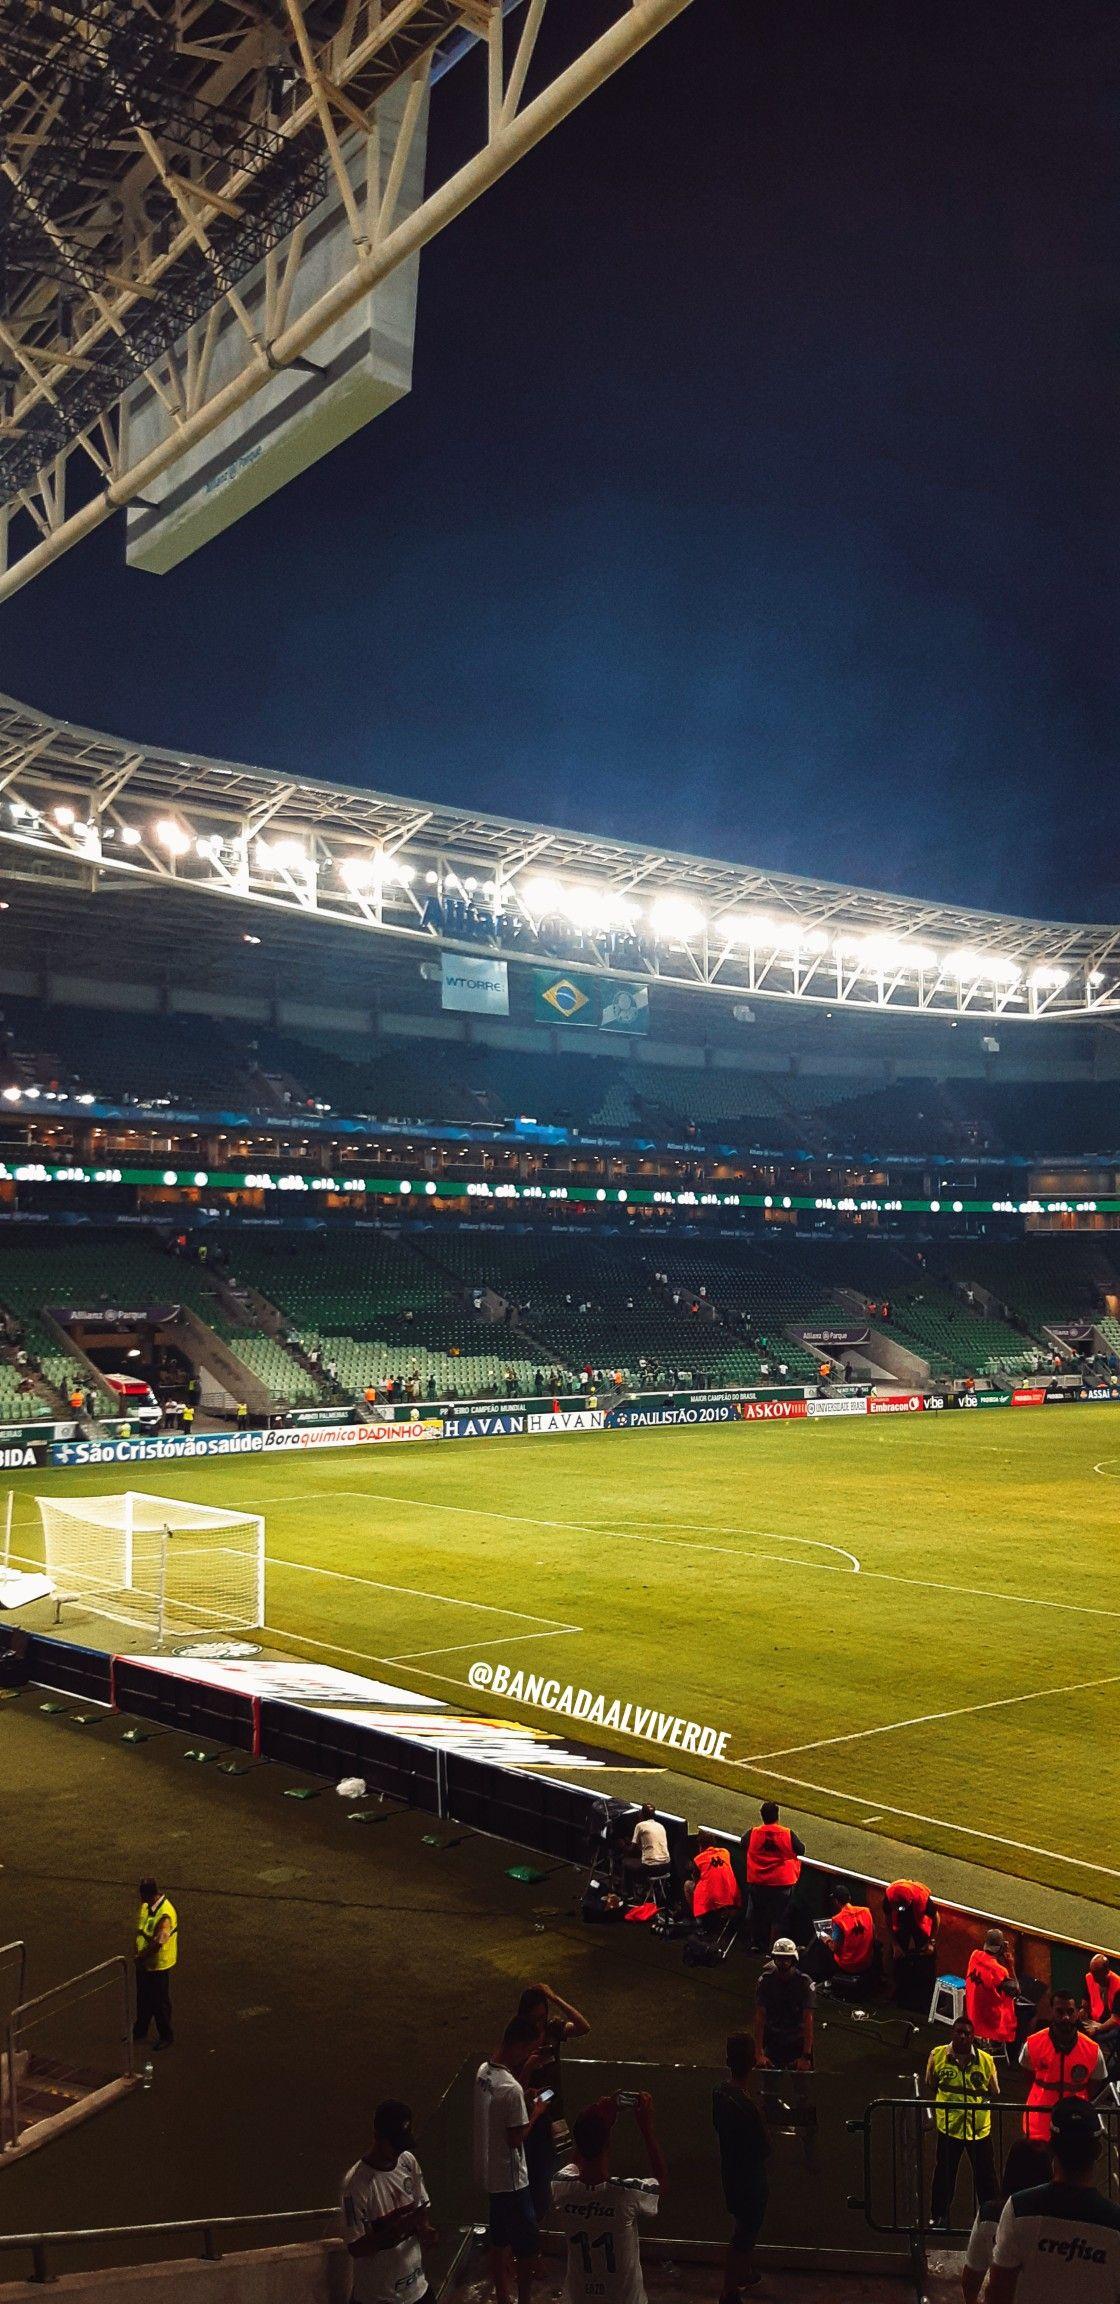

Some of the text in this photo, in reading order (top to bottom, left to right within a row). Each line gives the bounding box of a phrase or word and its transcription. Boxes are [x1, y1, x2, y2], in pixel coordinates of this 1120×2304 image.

[630, 1407, 729, 1426] PAULISTÃO 2019
[746, 1402, 791, 1419] ASKOV
[444, 1416, 525, 1438] HAVAN
[531, 1412, 602, 1432] HAVAN
[358, 1425, 424, 1441] DADINHO
[75, 1443, 115, 1464] São
[208, 1432, 263, 1454] saúde
[569, 2230, 616, 2274] 11
[1038, 2237, 1106, 2264] crefisa
